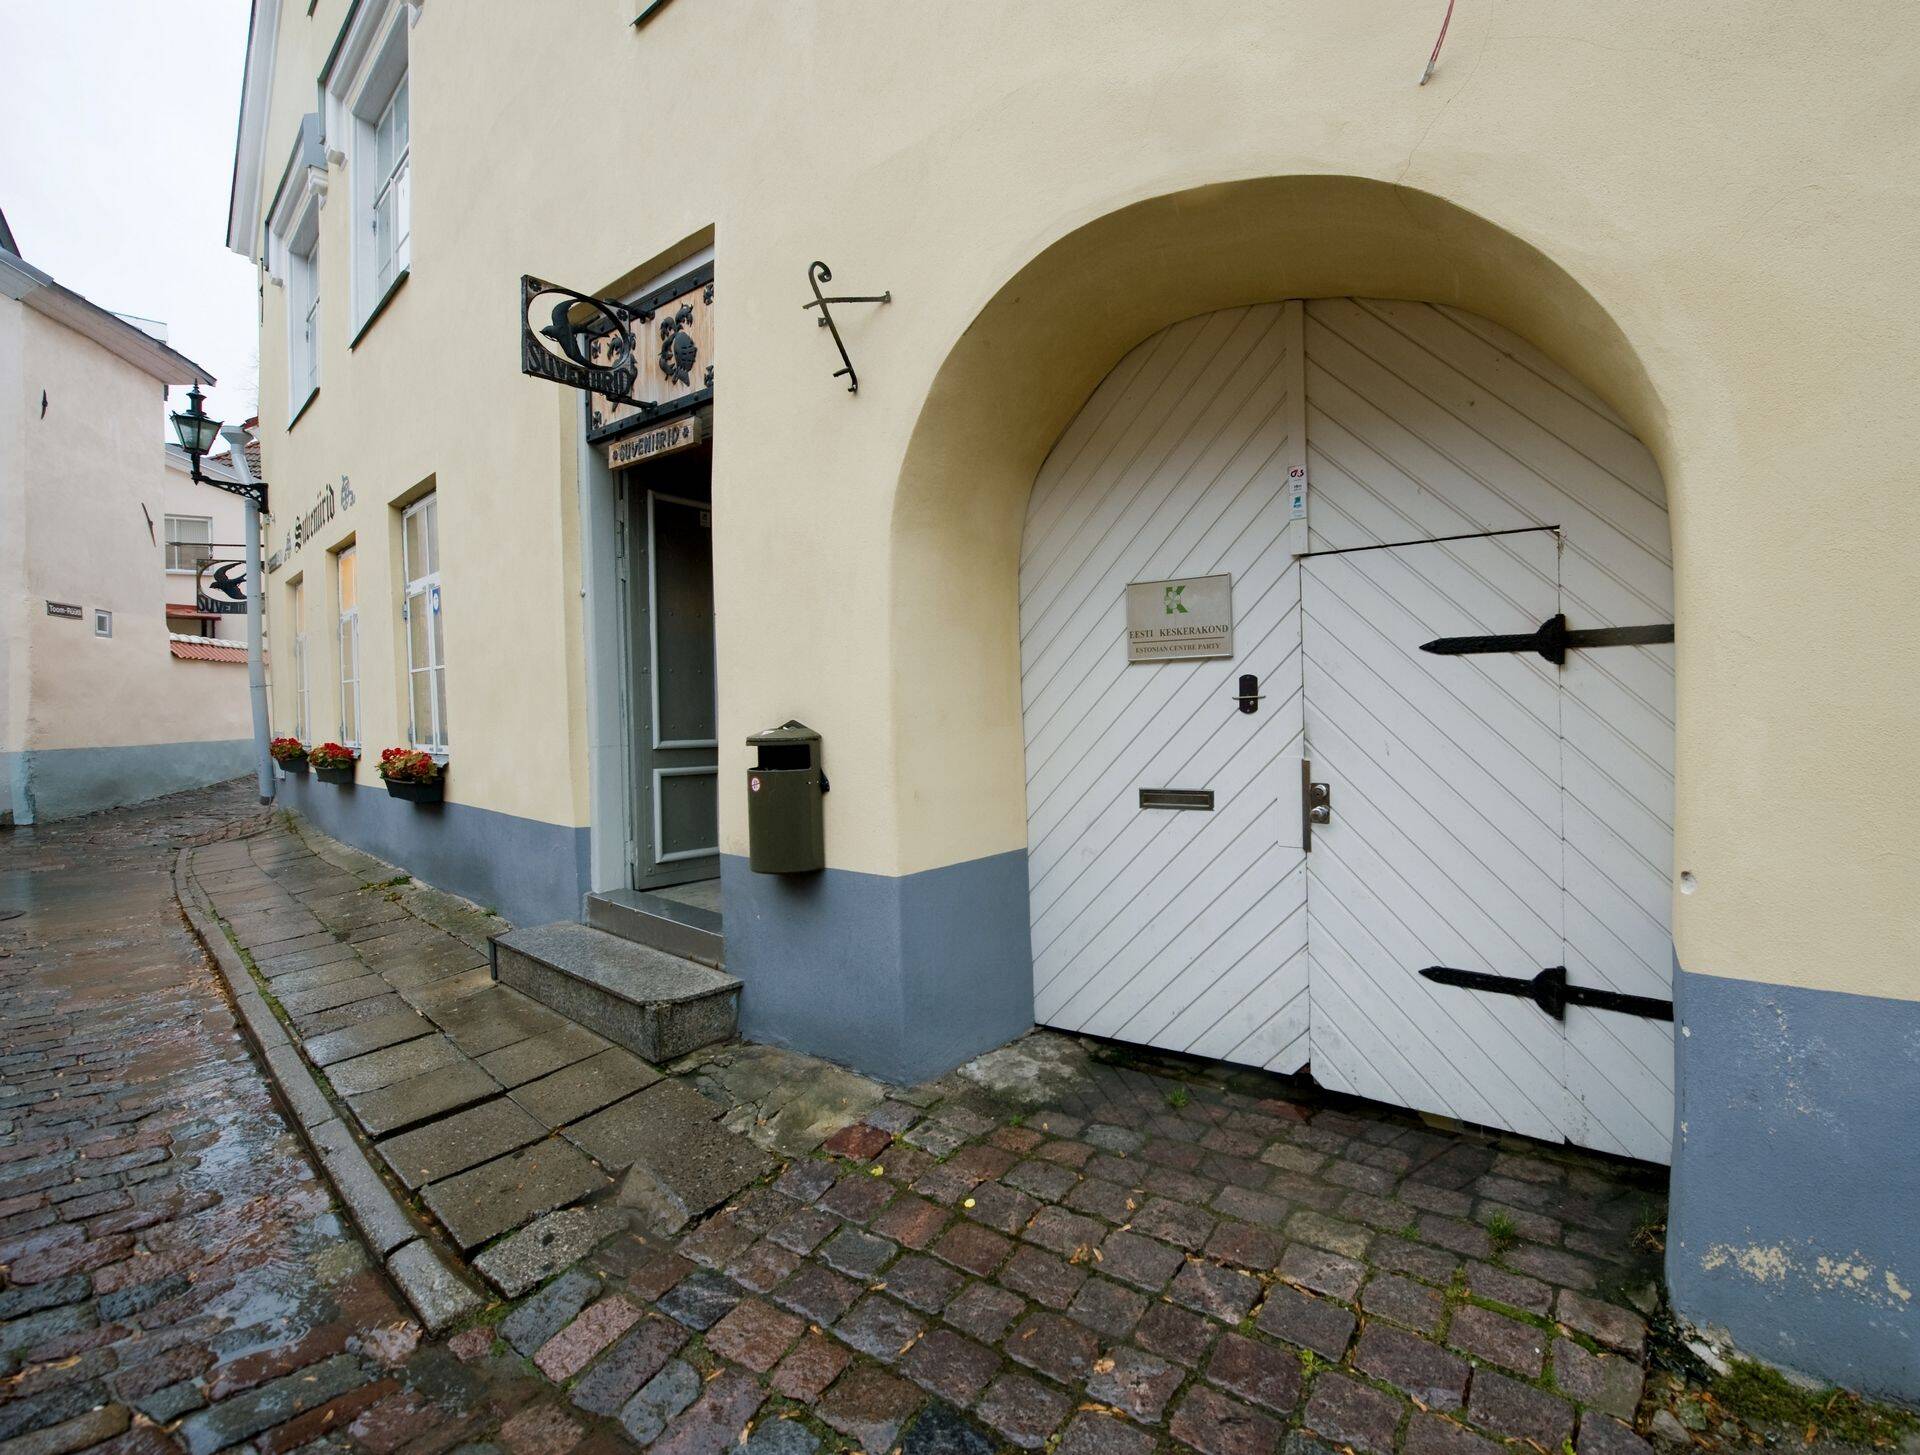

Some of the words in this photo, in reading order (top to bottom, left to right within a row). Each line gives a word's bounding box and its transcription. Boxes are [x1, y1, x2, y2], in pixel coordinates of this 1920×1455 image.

[619, 425, 680, 461] SUVENIIRID
[197, 595, 248, 613] SUVENII
[1129, 629, 1154, 639] EESTI
[1159, 624, 1229, 637] KESKERAKOND
[1135, 645, 1168, 654] ESTONIAN
[1169, 643, 1196, 652] CENTRE
[1197, 642, 1221, 651] PARTY
